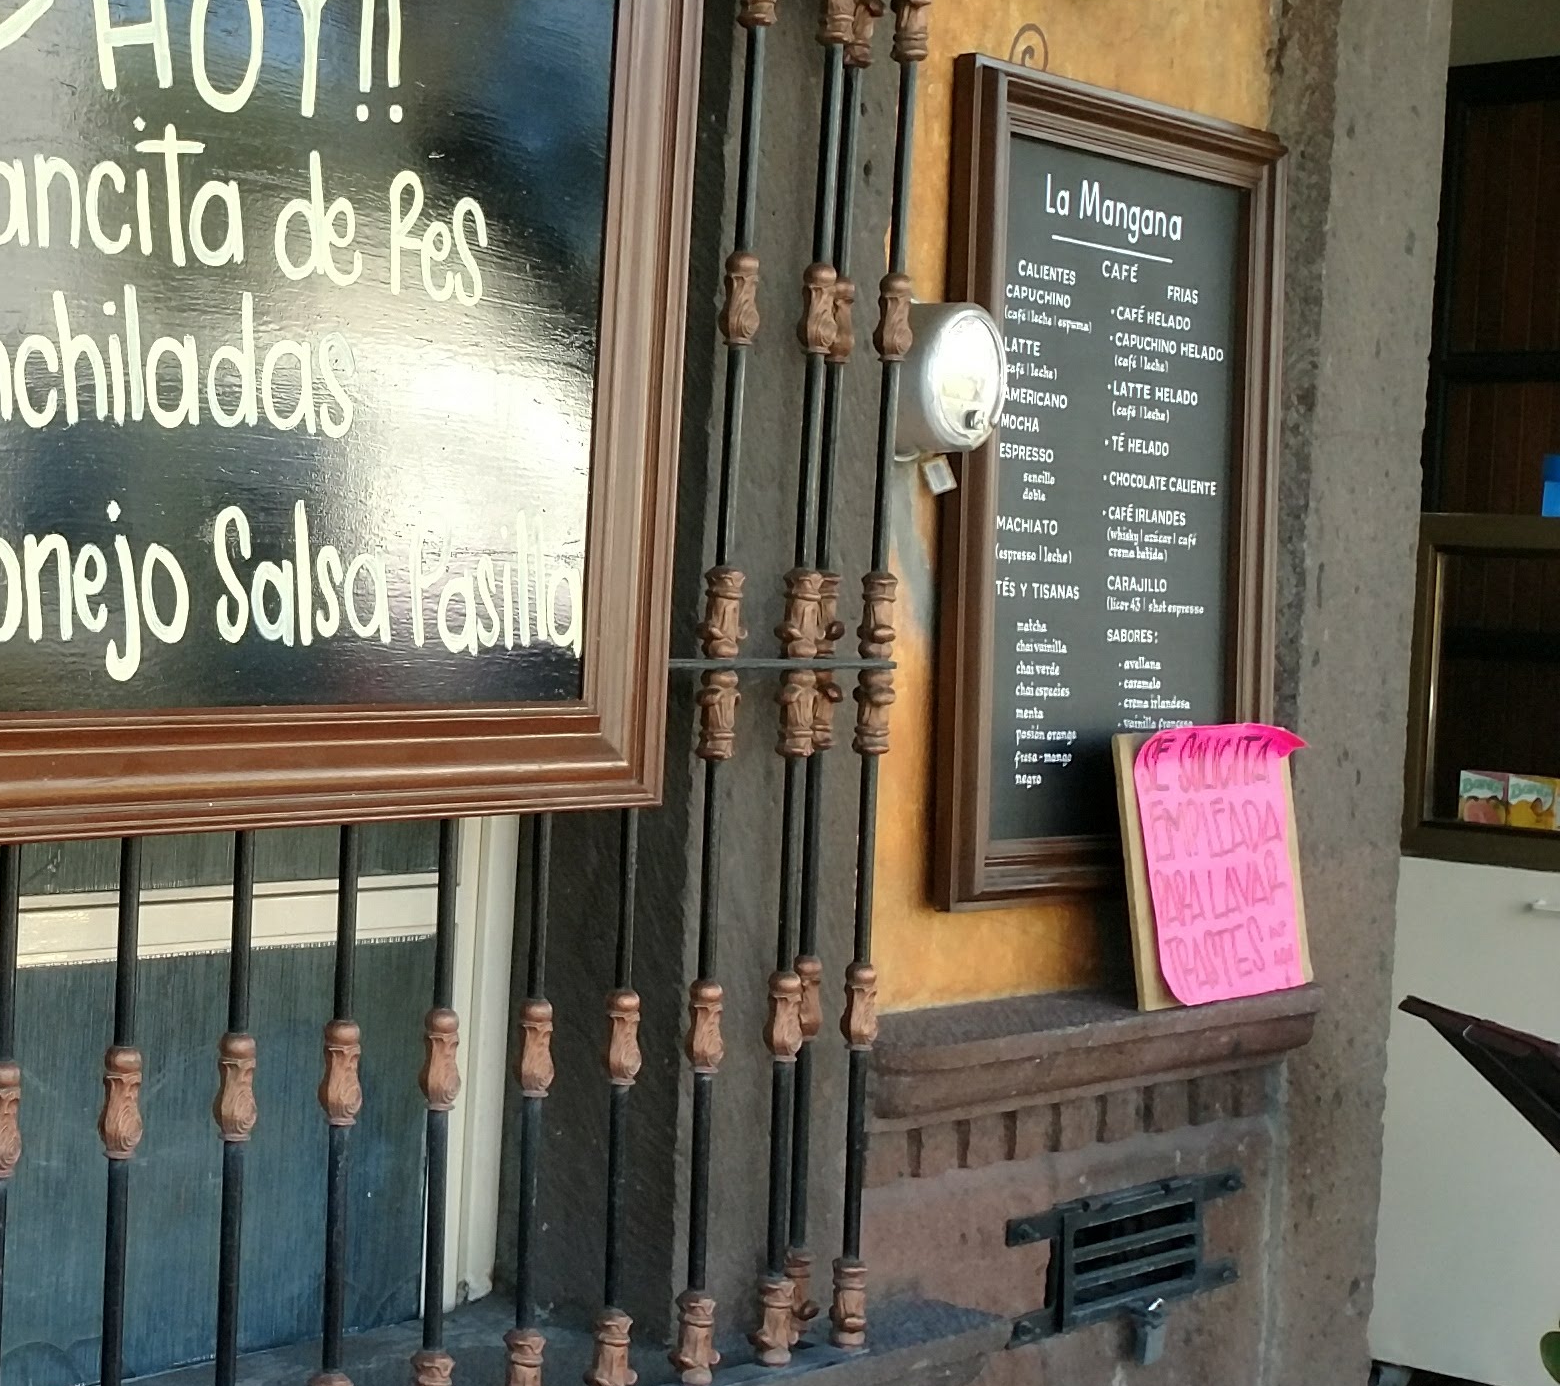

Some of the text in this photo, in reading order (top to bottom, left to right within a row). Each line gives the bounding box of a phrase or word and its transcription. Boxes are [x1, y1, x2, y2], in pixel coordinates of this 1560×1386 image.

[1045, 173, 1182, 244] La Mangana
[274, 150, 363, 287] de
[389, 170, 488, 306] Res
[1018, 259, 1076, 286] CALIENTES
[1102, 260, 1139, 283] CAFÉ
[1006, 284, 1071, 309] CAPUCHINO
[1167, 285, 1199, 304] FRIAS
[1116, 305, 1191, 331] CAFÉ HELADO
[1004, 336, 1041, 357] LATTE
[1115, 332, 1224, 362] CAPUCHINO HELADO
[1005, 386, 1068, 409] AMERICANO
[1113, 380, 1198, 406] LATTE HELADO
[1001, 413, 1040, 433] MOCHA
[1000, 442, 1054, 463] ESPRESSO
[1111, 432, 1170, 457] TÉ HELADO
[1022, 487, 1046, 502] doble
[1109, 471, 1217, 496] CHOCOLATE CALIENTE
[996, 515, 1058, 535] MACHIATO
[1108, 503, 1186, 526] CAFÉ IRLANDES
[214, 499, 391, 647] Salsa
[409, 509, 582, 659] Pasilla
[995, 576, 1080, 600] TÉS Y TISANAS
[1107, 575, 1167, 593] CARAJILLO
